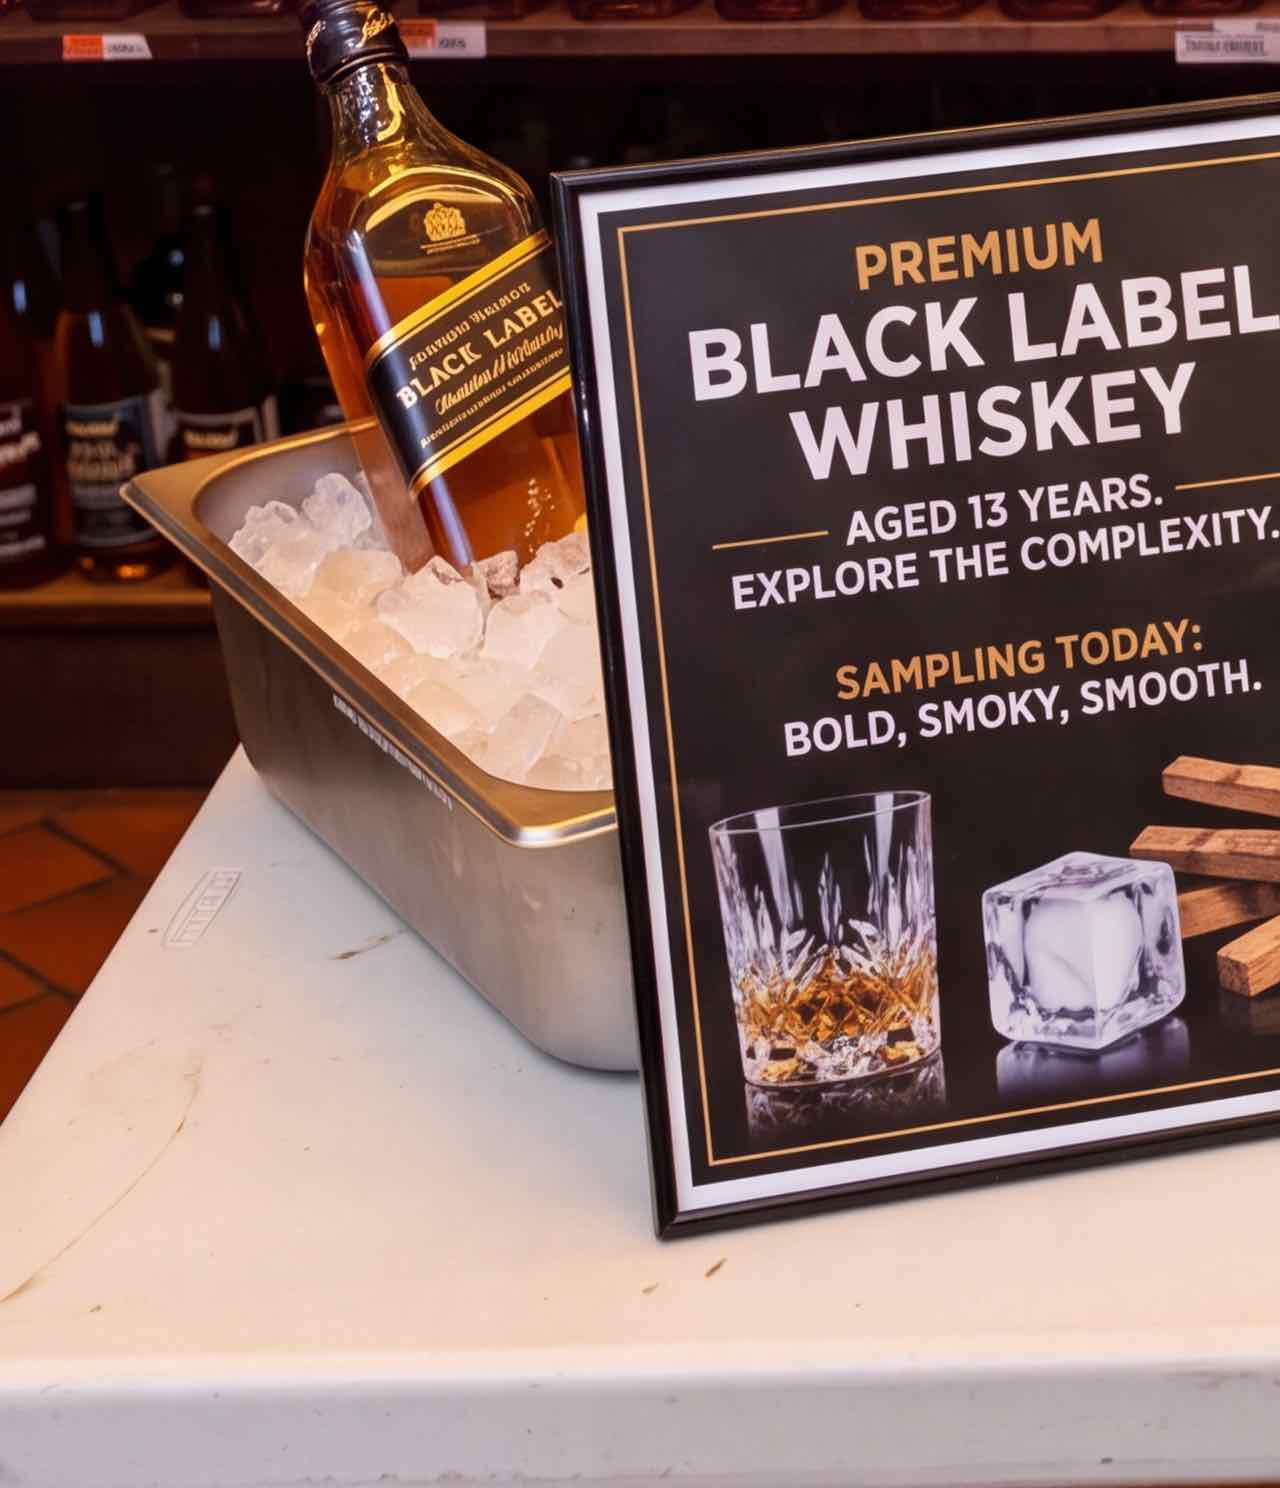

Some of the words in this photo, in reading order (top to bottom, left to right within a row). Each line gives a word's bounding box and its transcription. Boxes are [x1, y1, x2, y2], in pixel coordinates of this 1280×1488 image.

[857, 217, 1104, 291] PREMIUM
[688, 300, 985, 402] BLACK
[1010, 265, 1280, 364] LABEL
[788, 362, 1197, 481] WHISKEY
[731, 553, 920, 612] EXPLORE
[929, 541, 1008, 583] THE
[1020, 506, 1280, 573] COMPLEXITY.
[846, 499, 959, 546] AGED
[970, 494, 1007, 530] 13
[1018, 474, 1163, 524] YEARS.
[784, 707, 908, 757] BOLD,
[918, 686, 1070, 742] SMOKY,
[1080, 659, 1262, 716] SMOOTH.
[836, 639, 1048, 701] SAMPLING
[1057, 620, 1203, 669] TODAY:
